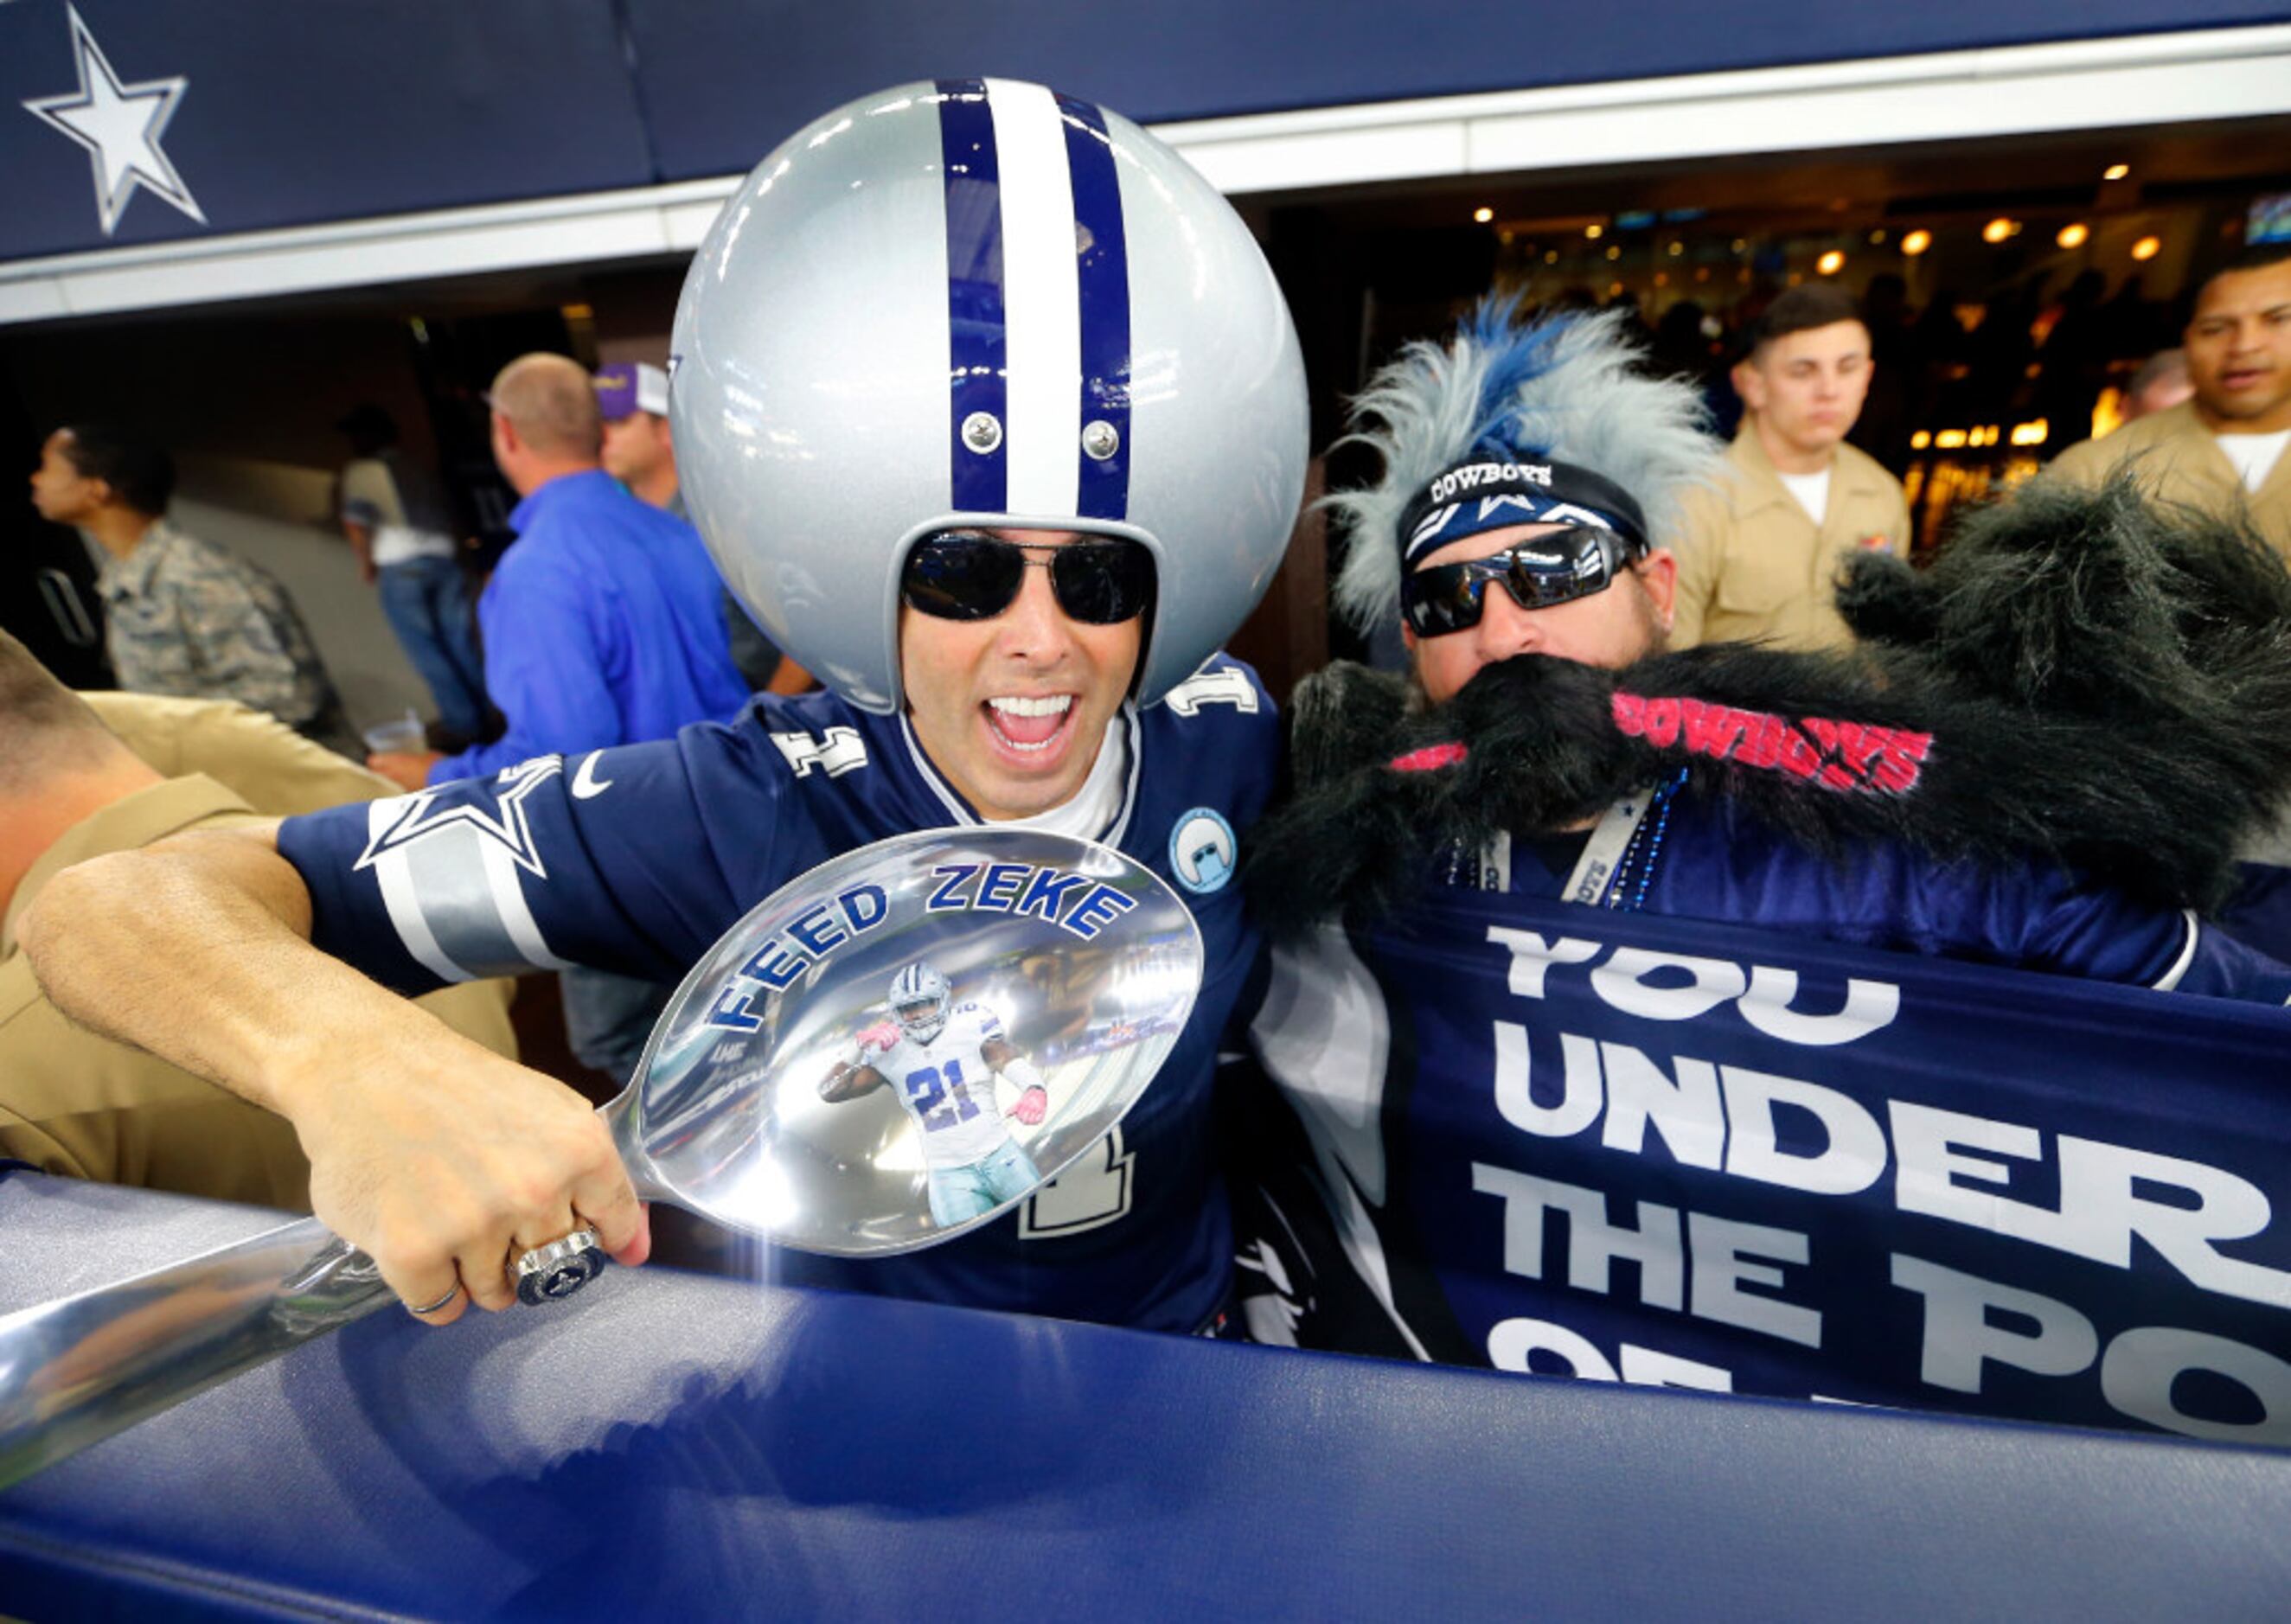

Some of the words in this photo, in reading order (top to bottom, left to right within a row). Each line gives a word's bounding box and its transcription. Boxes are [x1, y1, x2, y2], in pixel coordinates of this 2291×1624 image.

[1430, 462, 1552, 503] COWBOYS
[703, 883, 891, 1034] FEED
[925, 863, 1139, 942] ZEKE
[1487, 925, 1900, 1046] YOU
[906, 1058, 981, 1133] 21
[1494, 1020, 2291, 1310] UNDER
[1471, 1161, 1822, 1350] THE
